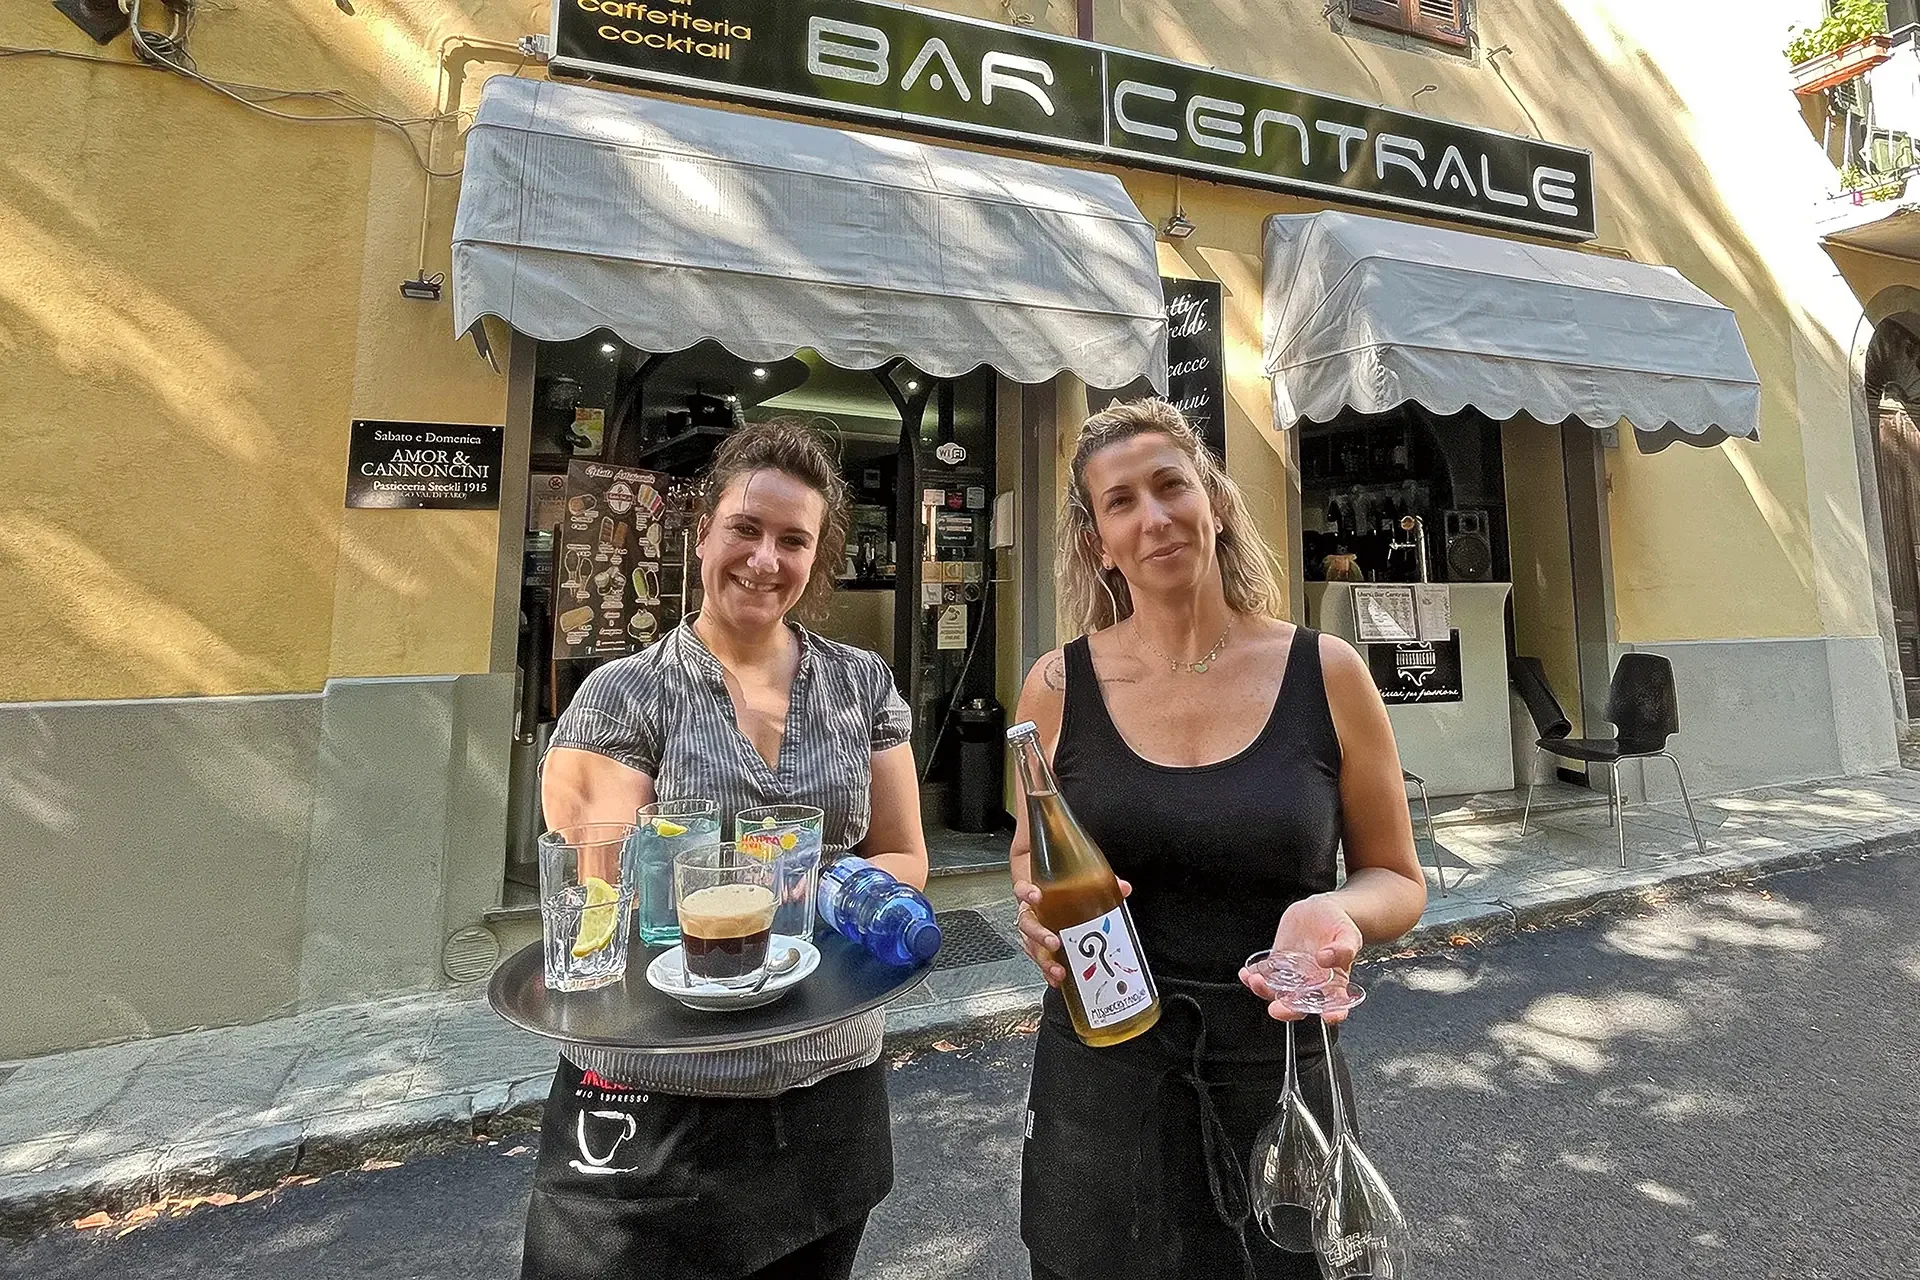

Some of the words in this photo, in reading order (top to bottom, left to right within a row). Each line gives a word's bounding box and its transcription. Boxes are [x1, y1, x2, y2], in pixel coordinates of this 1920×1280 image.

[577, 0, 752, 41] caffetteria
[597, 25, 731, 61] cocktail
[806, 16, 1056, 117] BAR
[1114, 79, 1578, 217] CENTRALE
[374, 430, 413, 442] Sabato
[415, 434, 422, 442] e
[425, 432, 482, 444] Domenica
[390, 449, 450, 463] AMOR
[452, 450, 471, 466] &
[361, 462, 490, 478] CANNONCINI
[373, 480, 426, 492] Pasticceria
[463, 482, 488, 492] 1915
[575, 1089, 594, 1099] MIO
[599, 1092, 649, 1103] ESPRESSO
